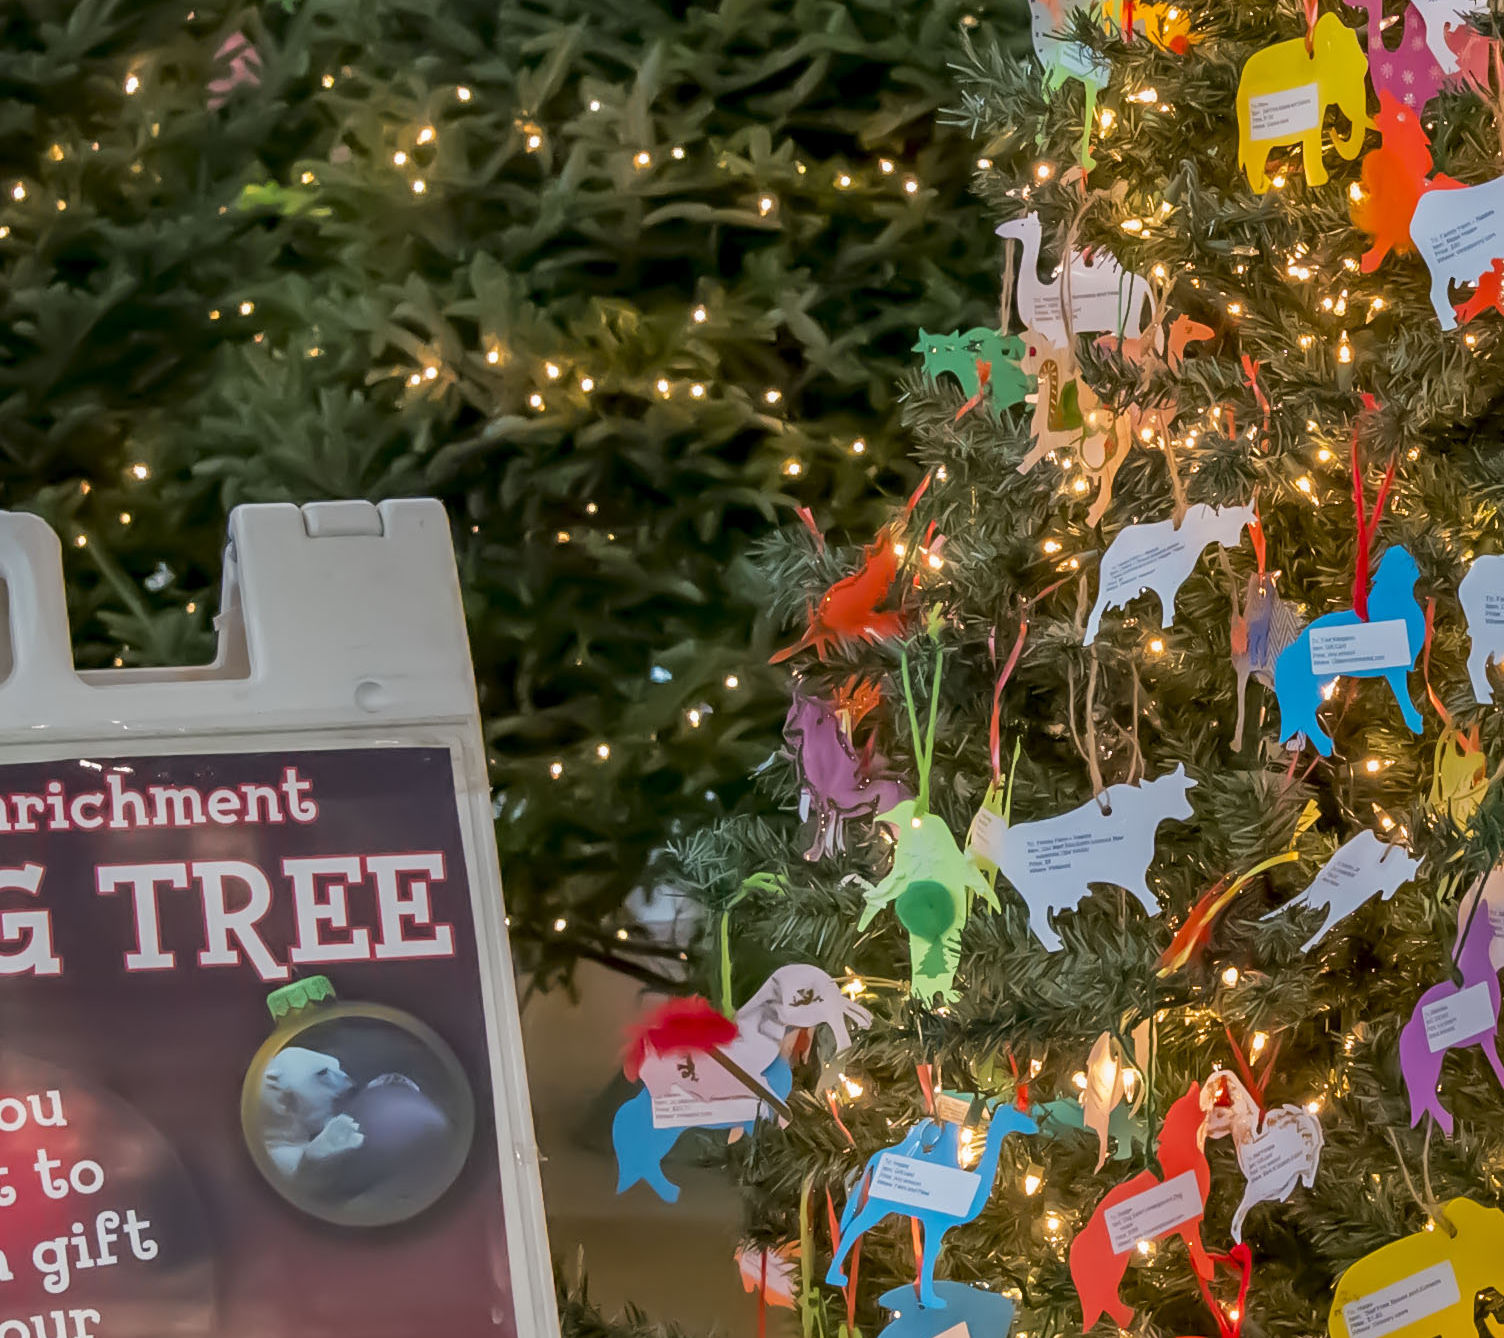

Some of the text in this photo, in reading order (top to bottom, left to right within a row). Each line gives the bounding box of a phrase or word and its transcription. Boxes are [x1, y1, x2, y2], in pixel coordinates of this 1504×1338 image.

[97, 853, 454, 980] TREE
[33, 1148, 105, 1200] to
[32, 1209, 159, 1294] gift
